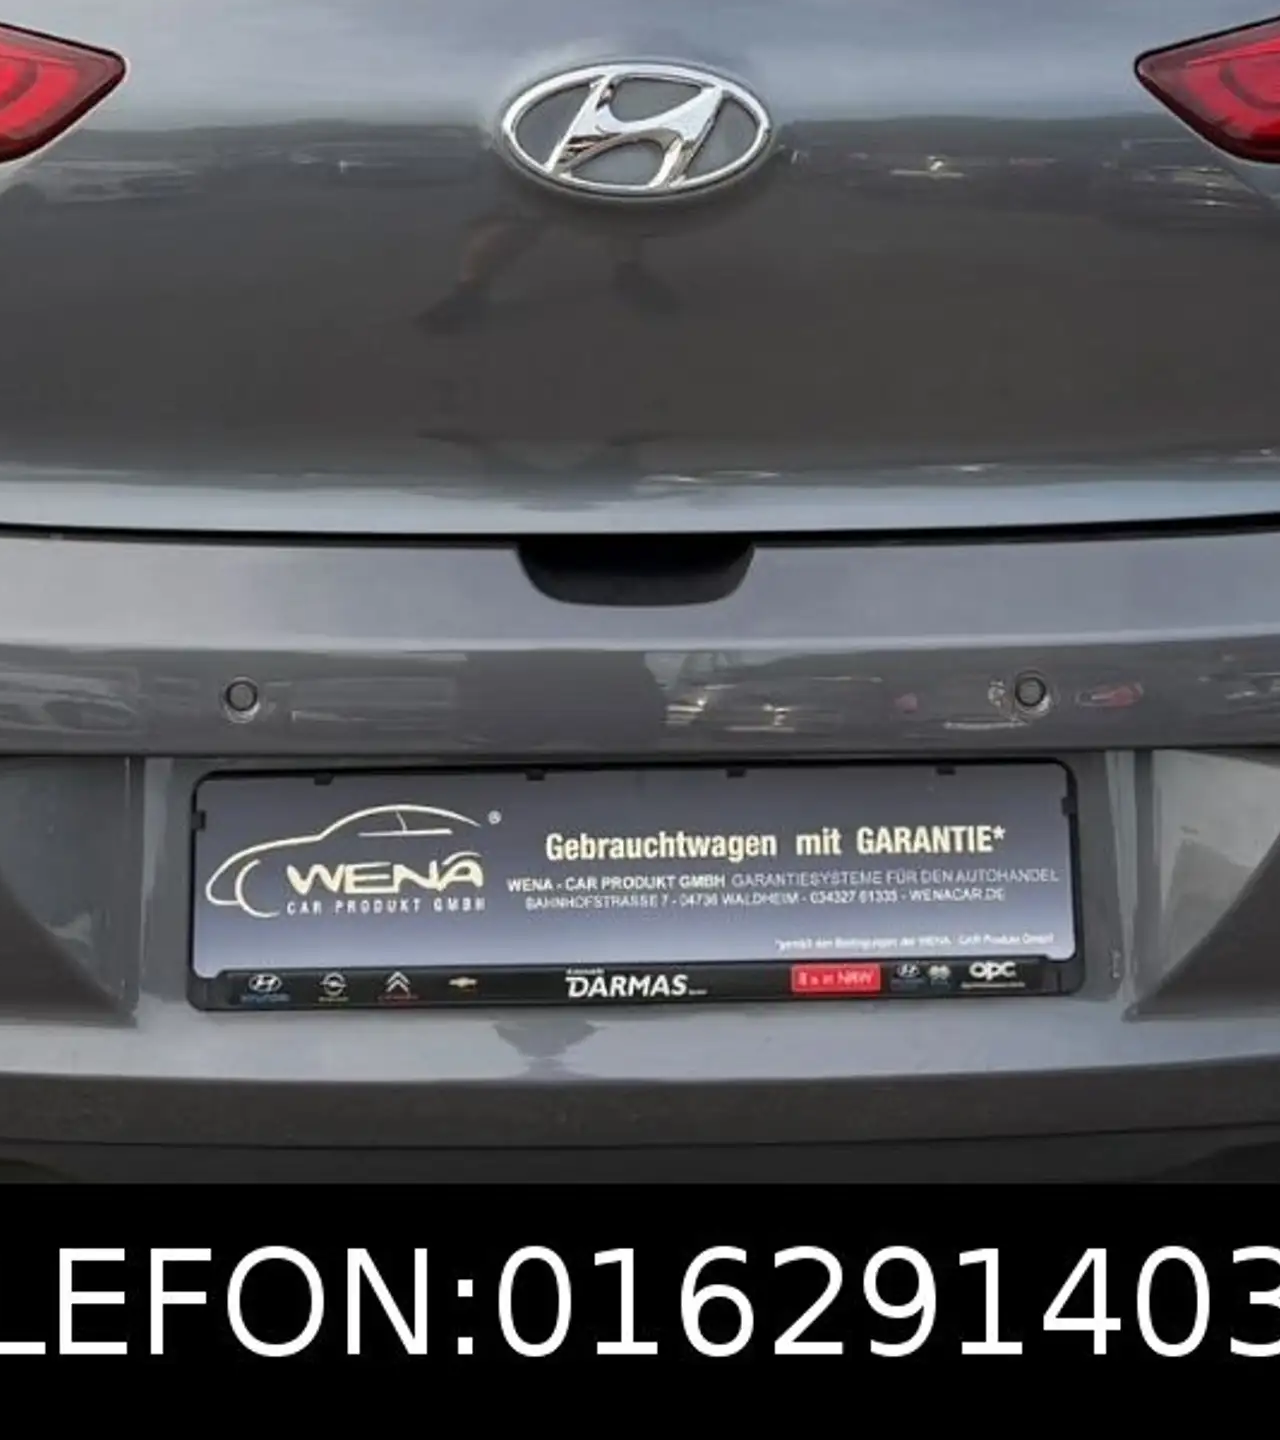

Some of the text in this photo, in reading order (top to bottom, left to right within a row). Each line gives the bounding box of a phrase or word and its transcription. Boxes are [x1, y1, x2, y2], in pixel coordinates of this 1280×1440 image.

[545, 829, 778, 863] Gebrauchtwagen
[796, 827, 842, 856] mit
[286, 853, 484, 895] WENA
[506, 877, 553, 892] WENA
[564, 876, 598, 891] CAR
[601, 875, 677, 890] PRODUKT
[678, 873, 726, 889] GMBH
[731, 871, 882, 887] GARANTIESYSTEME
[886, 868, 918, 884] FÜR
[920, 868, 954, 883] DEN
[957, 867, 1060, 883] AUTOHANDEL
[286, 900, 322, 915] CAR
[334, 898, 421, 914] PRODUKT
[566, 975, 688, 997] DARMAS
